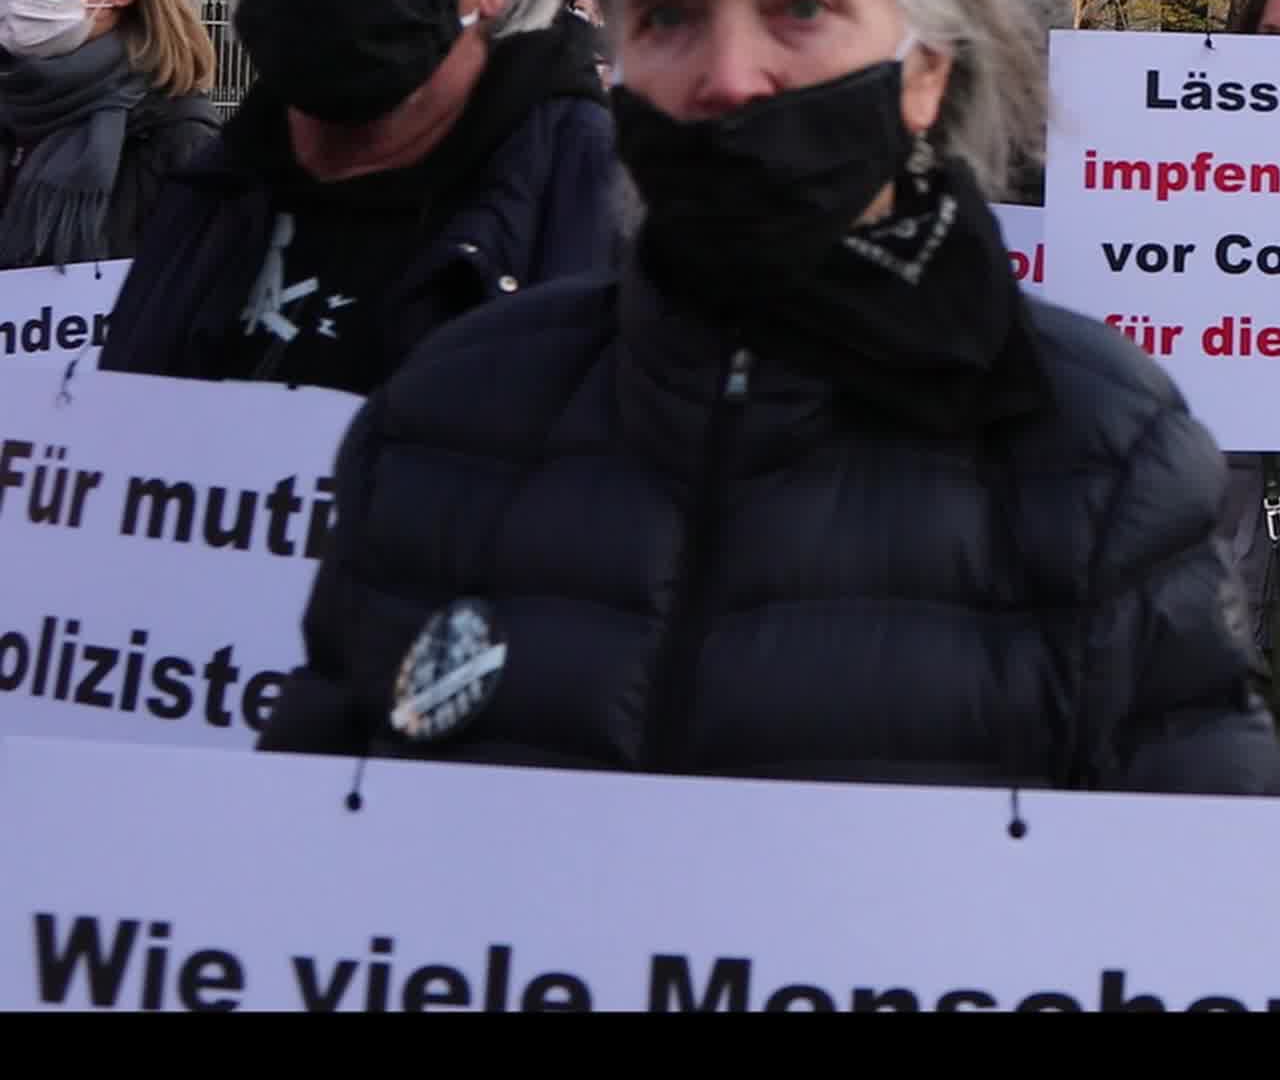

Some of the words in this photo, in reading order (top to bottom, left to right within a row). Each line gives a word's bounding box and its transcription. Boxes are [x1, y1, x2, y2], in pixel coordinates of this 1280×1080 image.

[1084, 151, 1280, 200] impfen
[1102, 241, 1195, 274] vor
[0, 439, 102, 529] Für
[32, 913, 246, 1011] Wie
[292, 936, 593, 1011] viele
